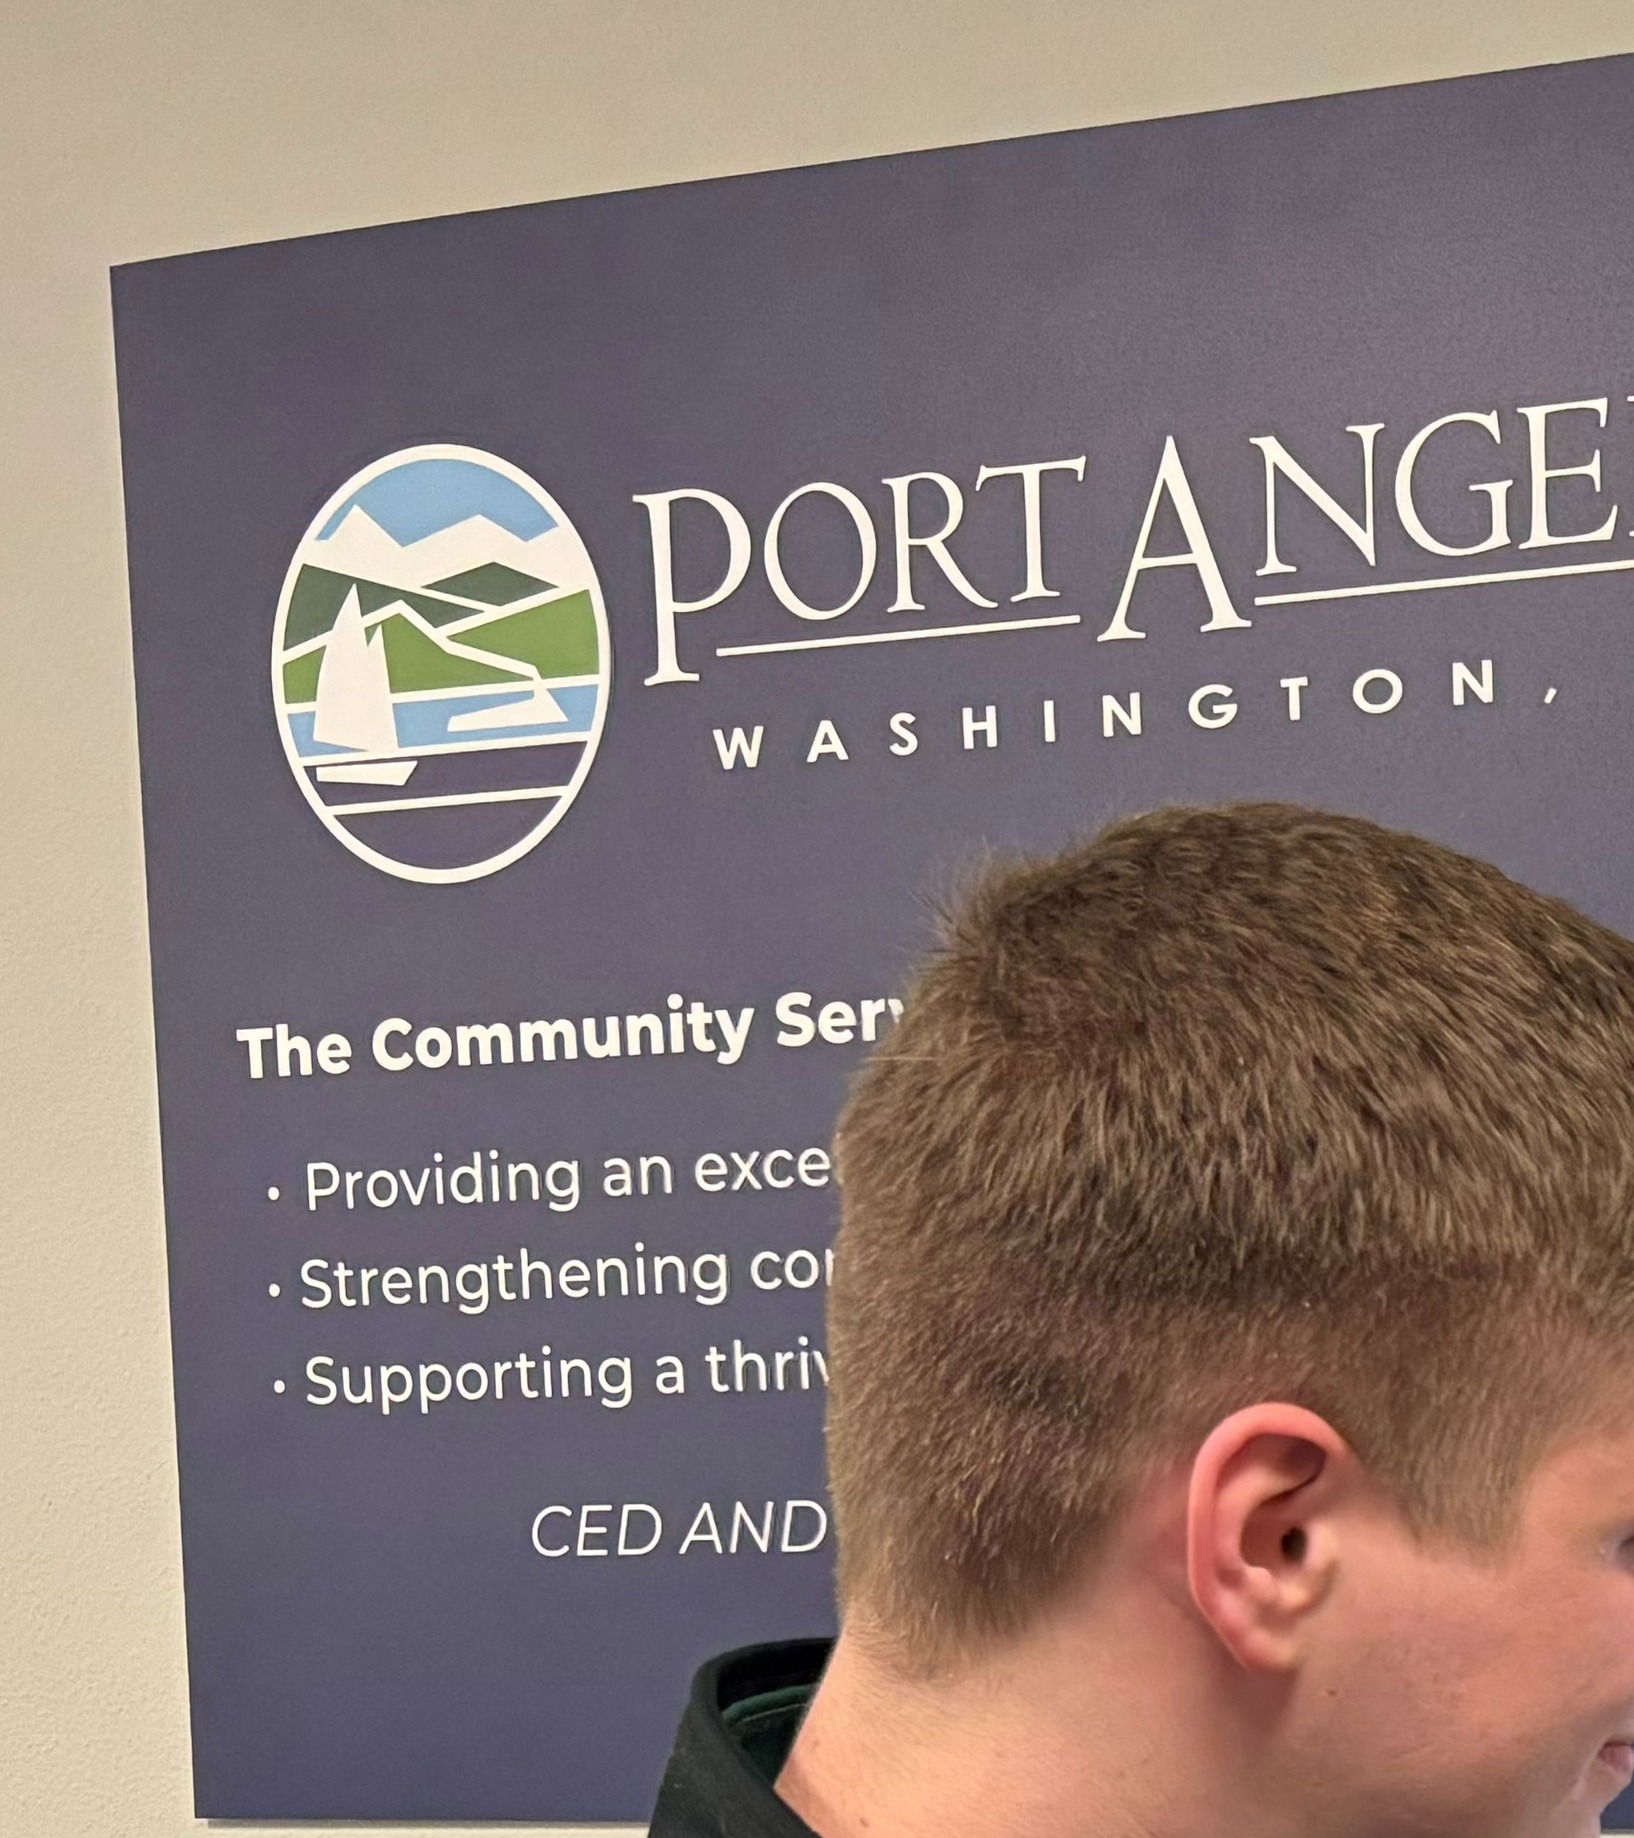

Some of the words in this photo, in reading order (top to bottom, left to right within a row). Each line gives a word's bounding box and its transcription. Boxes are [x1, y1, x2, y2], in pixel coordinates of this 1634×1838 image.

[632, 455, 1086, 687] PORT
[713, 658, 1560, 771] WASHINGTON,
[235, 1022, 352, 1079] The
[371, 992, 755, 1071] Community
[306, 1149, 579, 1212] Providing
[602, 1155, 672, 1196] an
[694, 1147, 831, 1191] exce
[300, 1241, 727, 1314] Strengthening
[305, 1344, 632, 1415] Supporting
[655, 1355, 684, 1394] a
[531, 1503, 662, 1557] CED
[678, 1499, 827, 1554] AND
